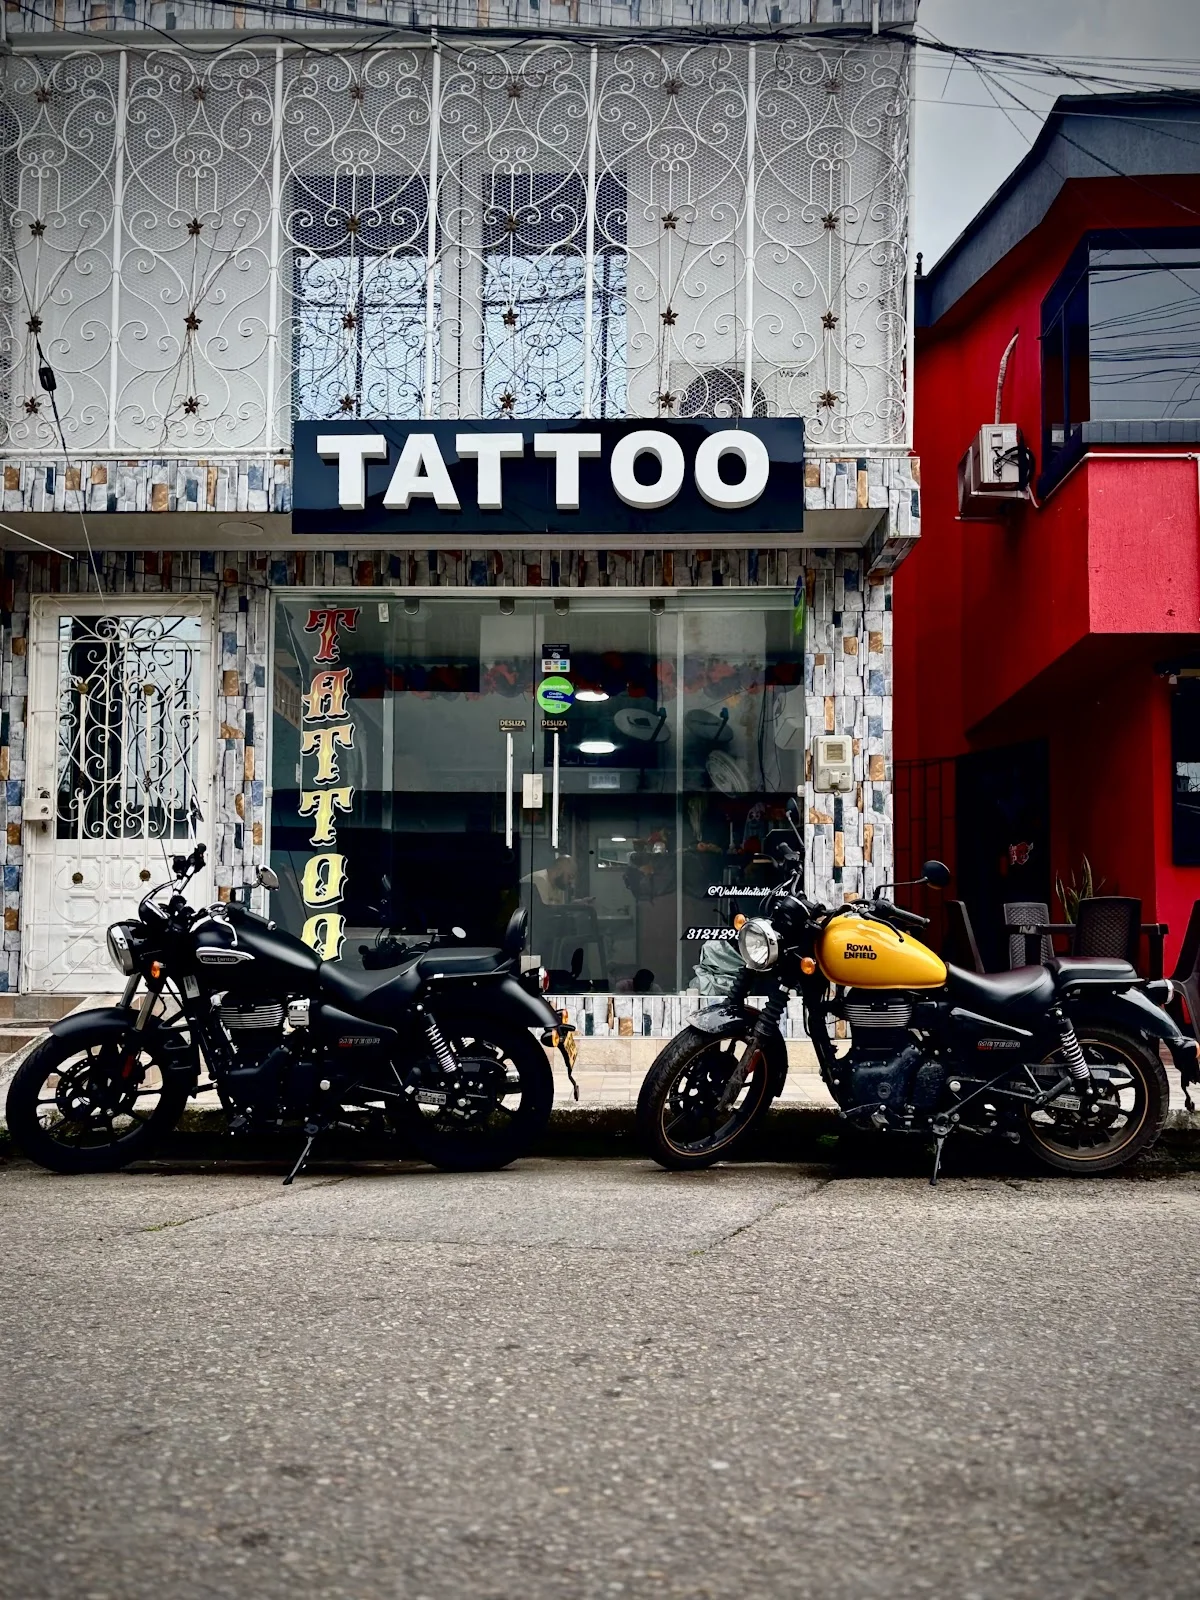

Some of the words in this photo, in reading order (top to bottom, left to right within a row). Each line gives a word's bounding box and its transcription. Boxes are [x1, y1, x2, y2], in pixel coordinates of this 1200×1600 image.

[317, 430, 770, 509] TATTOO
[299, 607, 360, 962] TATTOO
[844, 952, 877, 960] ENFIELD
[846, 943, 873, 952] ROYAL
